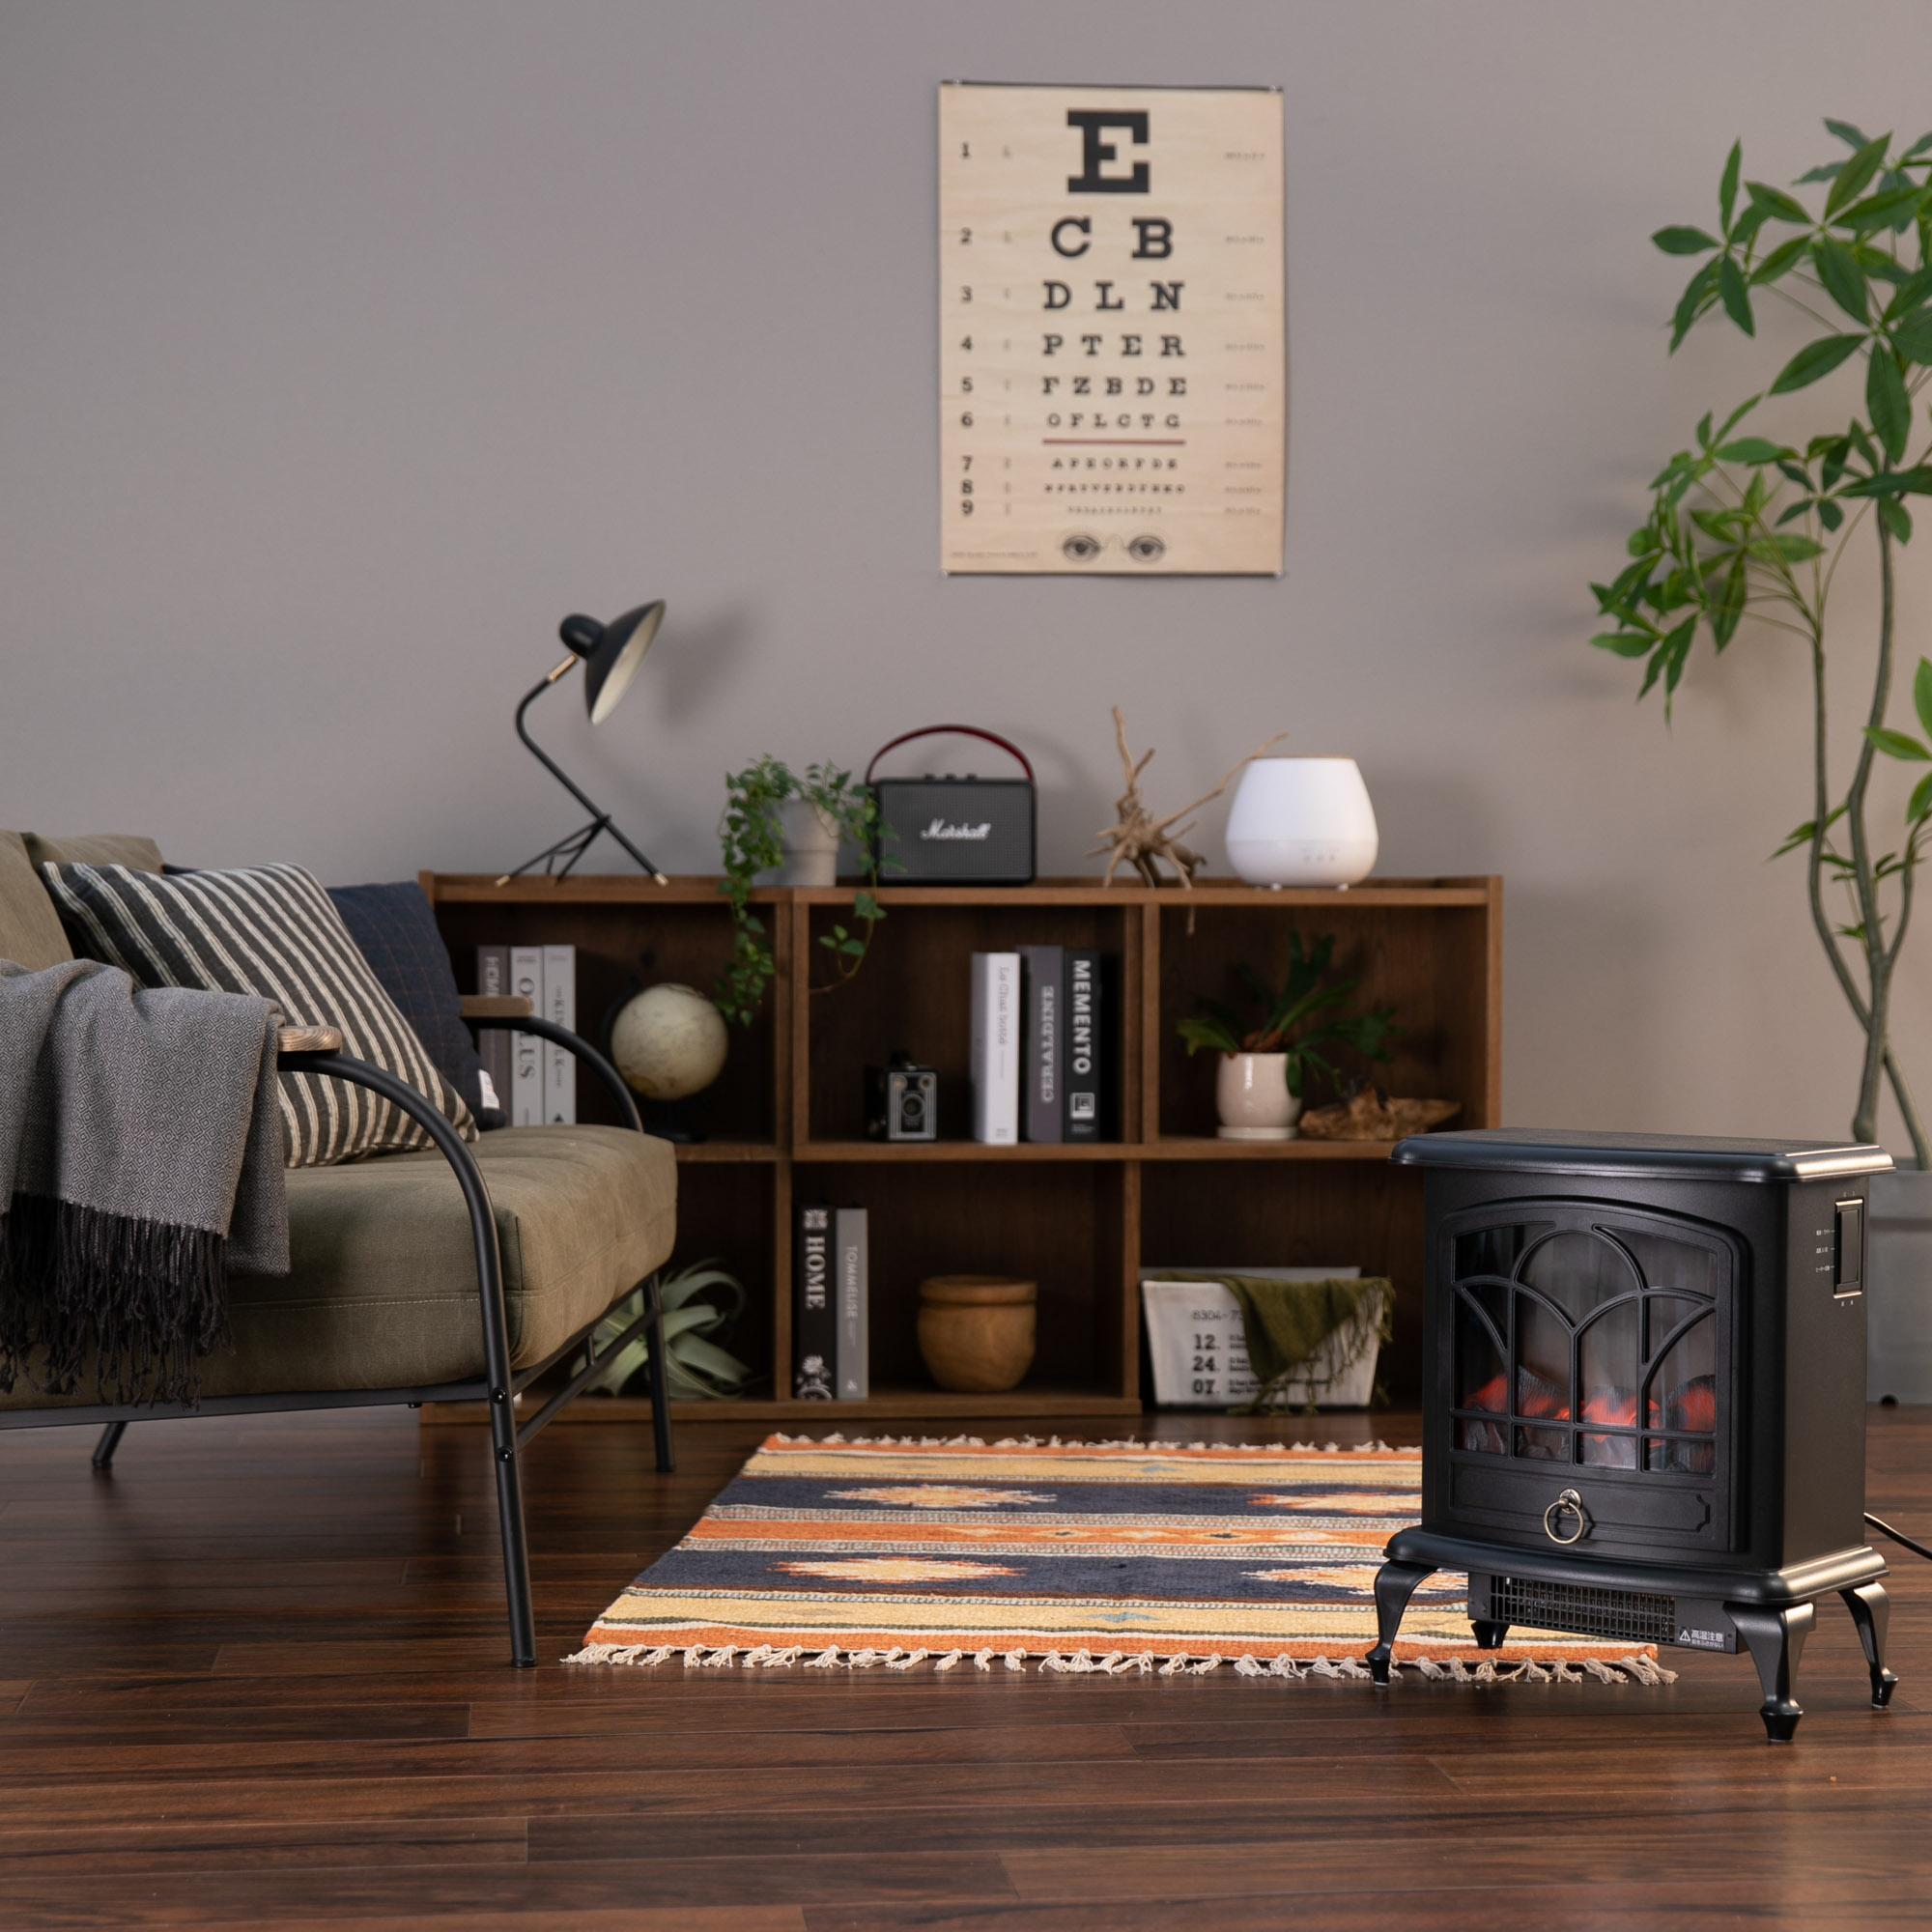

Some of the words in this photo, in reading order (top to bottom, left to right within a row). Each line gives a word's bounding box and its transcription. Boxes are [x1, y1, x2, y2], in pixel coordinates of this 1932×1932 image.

[961, 142, 971, 159] 1
[1065, 108, 1151, 194] E
[960, 227, 973, 245] 2
[1050, 215, 1092, 259] C
[1130, 217, 1174, 260] B
[961, 285, 973, 303] 3
[1042, 280, 1072, 310] D
[1094, 280, 1124, 311] L
[1150, 281, 1185, 311] N
[960, 335, 973, 351] 4
[961, 376, 974, 393] 5
[960, 412, 974, 428] 6
[962, 455, 973, 472] 7
[921, 818, 991, 840] Marshall
[1072, 959, 1092, 1074] MEMENTO
[806, 1236, 826, 1309] HOME
[1690, 1629, 1724, 1642] 高温注意
